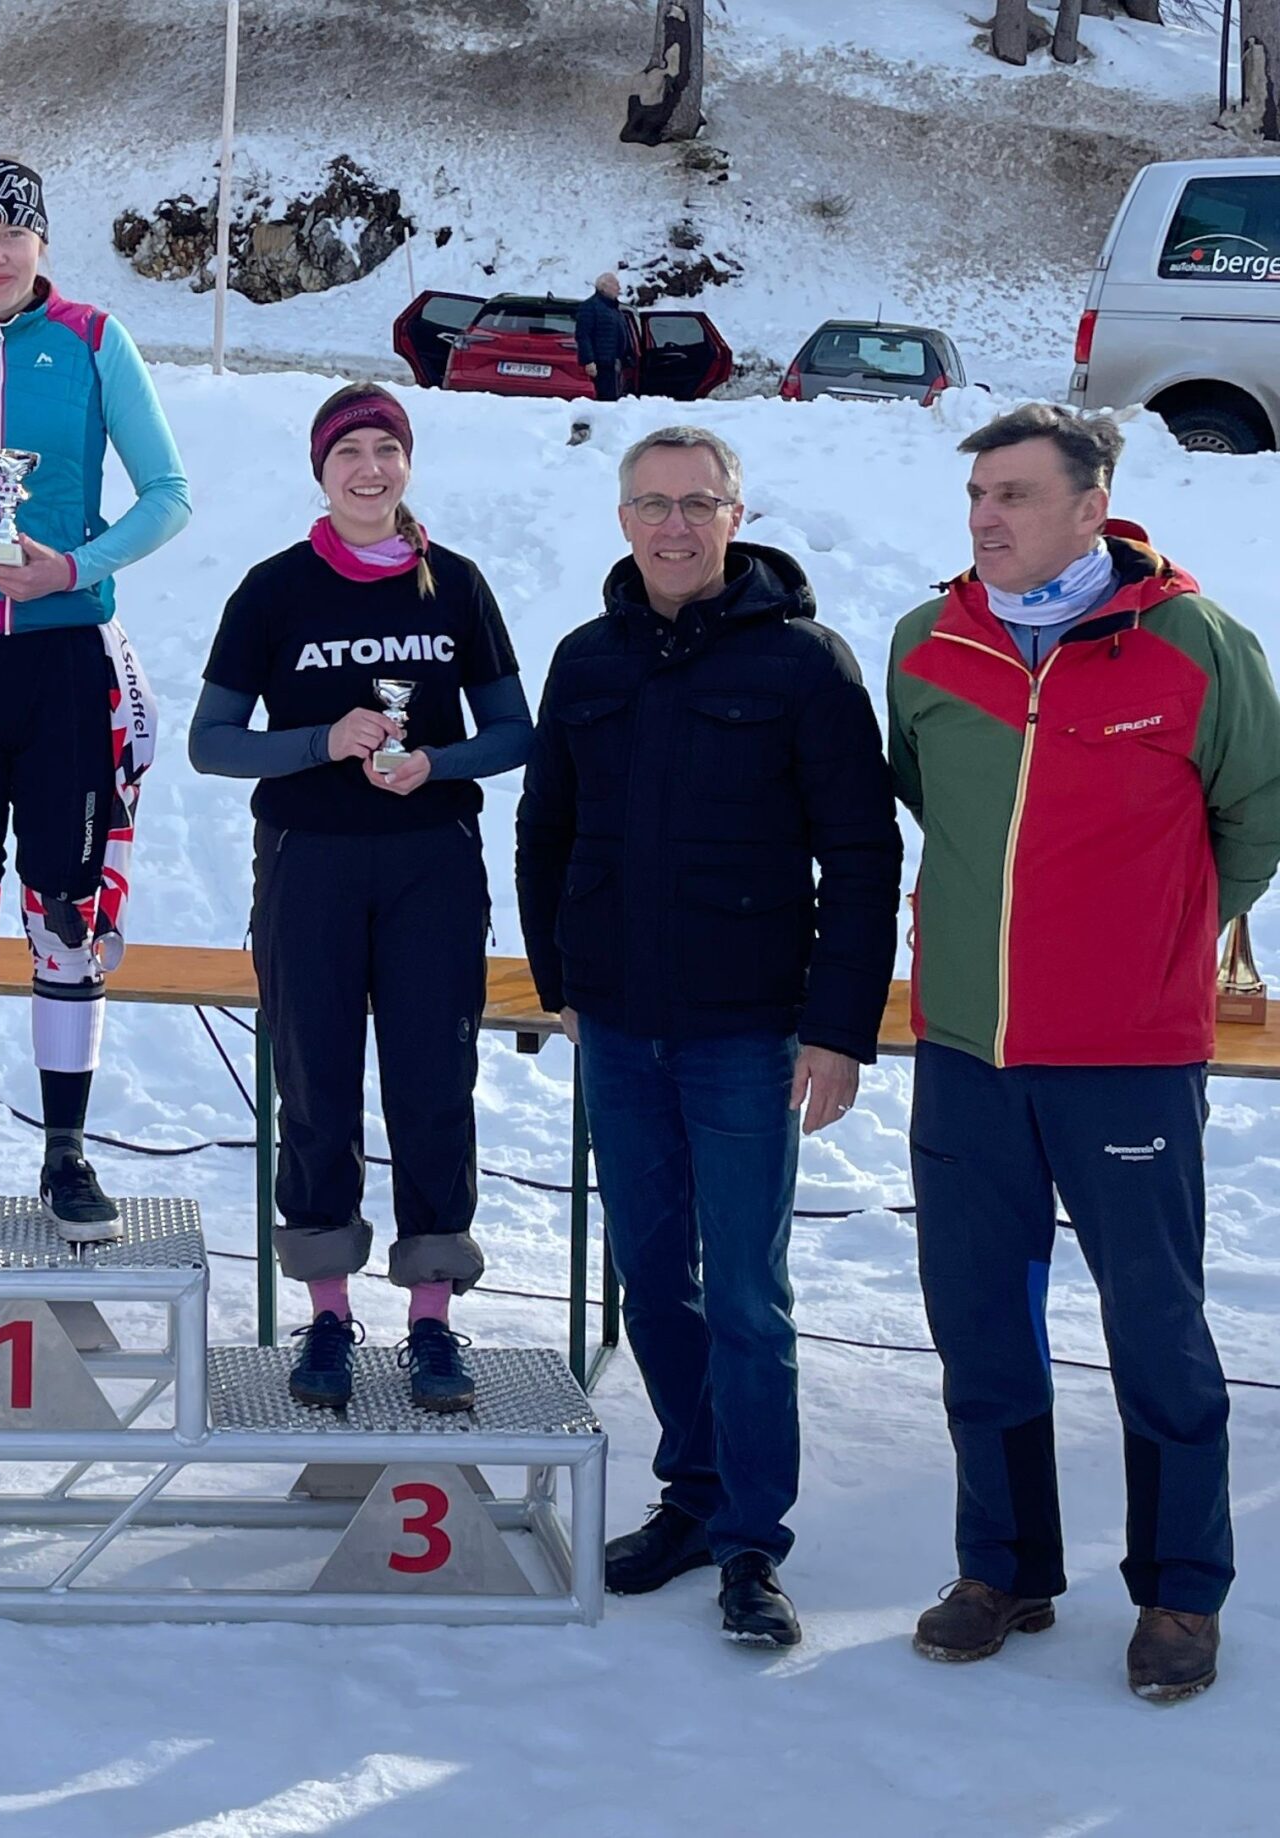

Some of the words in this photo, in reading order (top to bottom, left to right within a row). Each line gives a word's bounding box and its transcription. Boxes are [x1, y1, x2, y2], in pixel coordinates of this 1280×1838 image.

[122, 651, 150, 739] Schöffel
[295, 635, 455, 671] ATOMIC
[388, 1483, 453, 1575] 3
